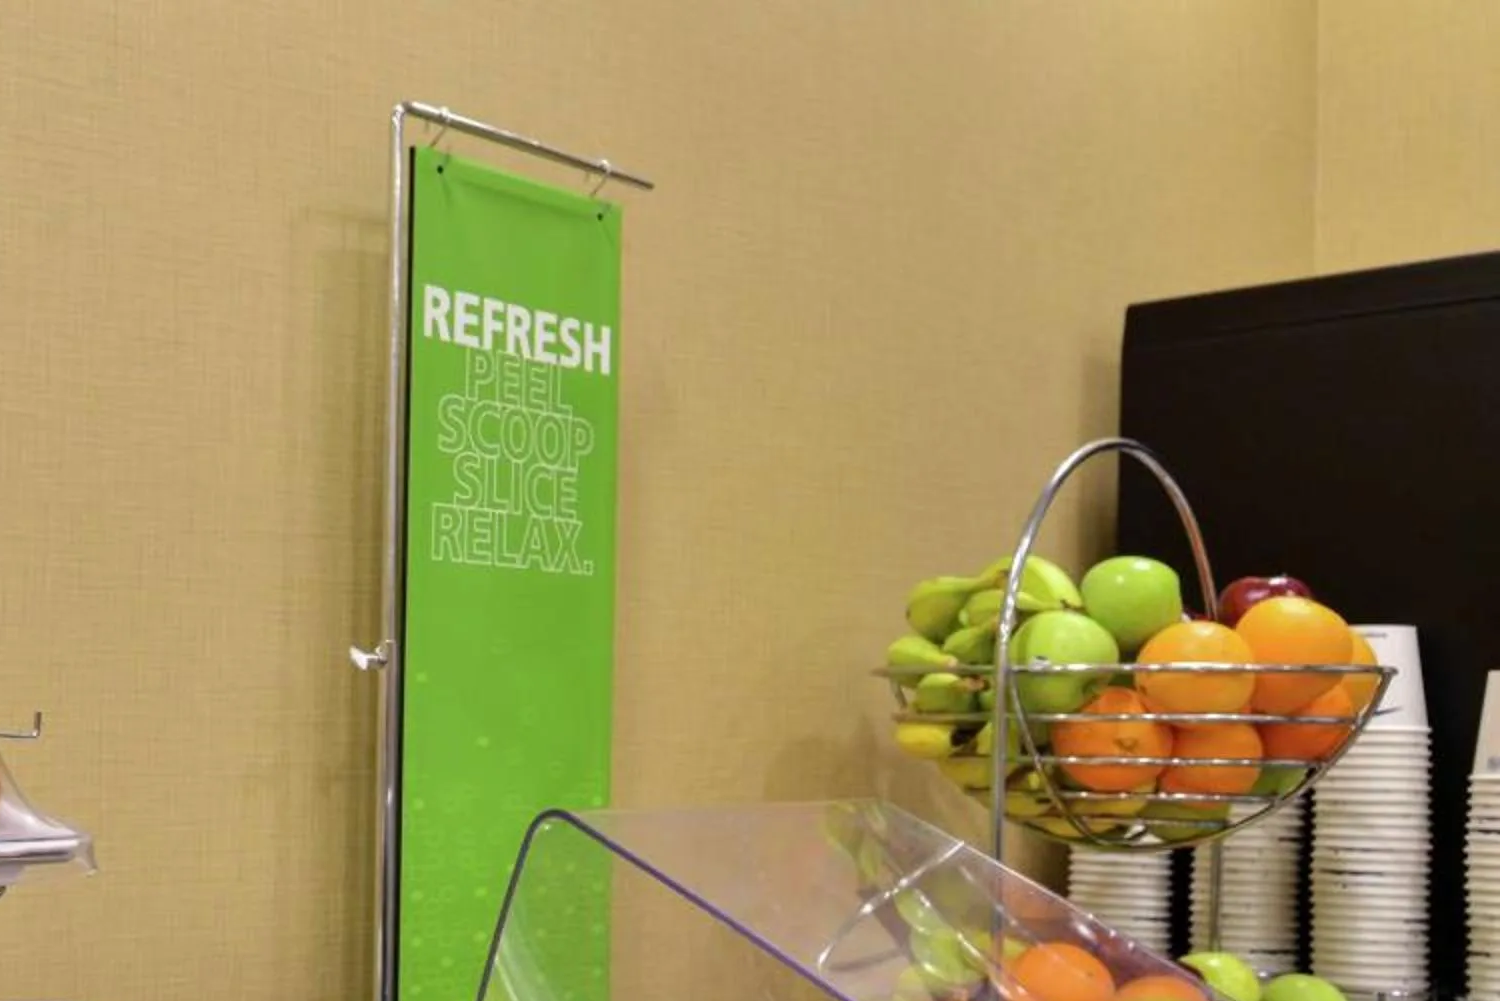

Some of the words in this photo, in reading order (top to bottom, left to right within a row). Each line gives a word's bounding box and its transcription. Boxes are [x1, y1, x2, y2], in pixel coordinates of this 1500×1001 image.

[424, 284, 612, 375] REFRESH
[466, 346, 573, 418] PEEL
[437, 394, 594, 473] SCOOP
[453, 452, 579, 522] SLICE
[431, 503, 594, 576] RELAX.
